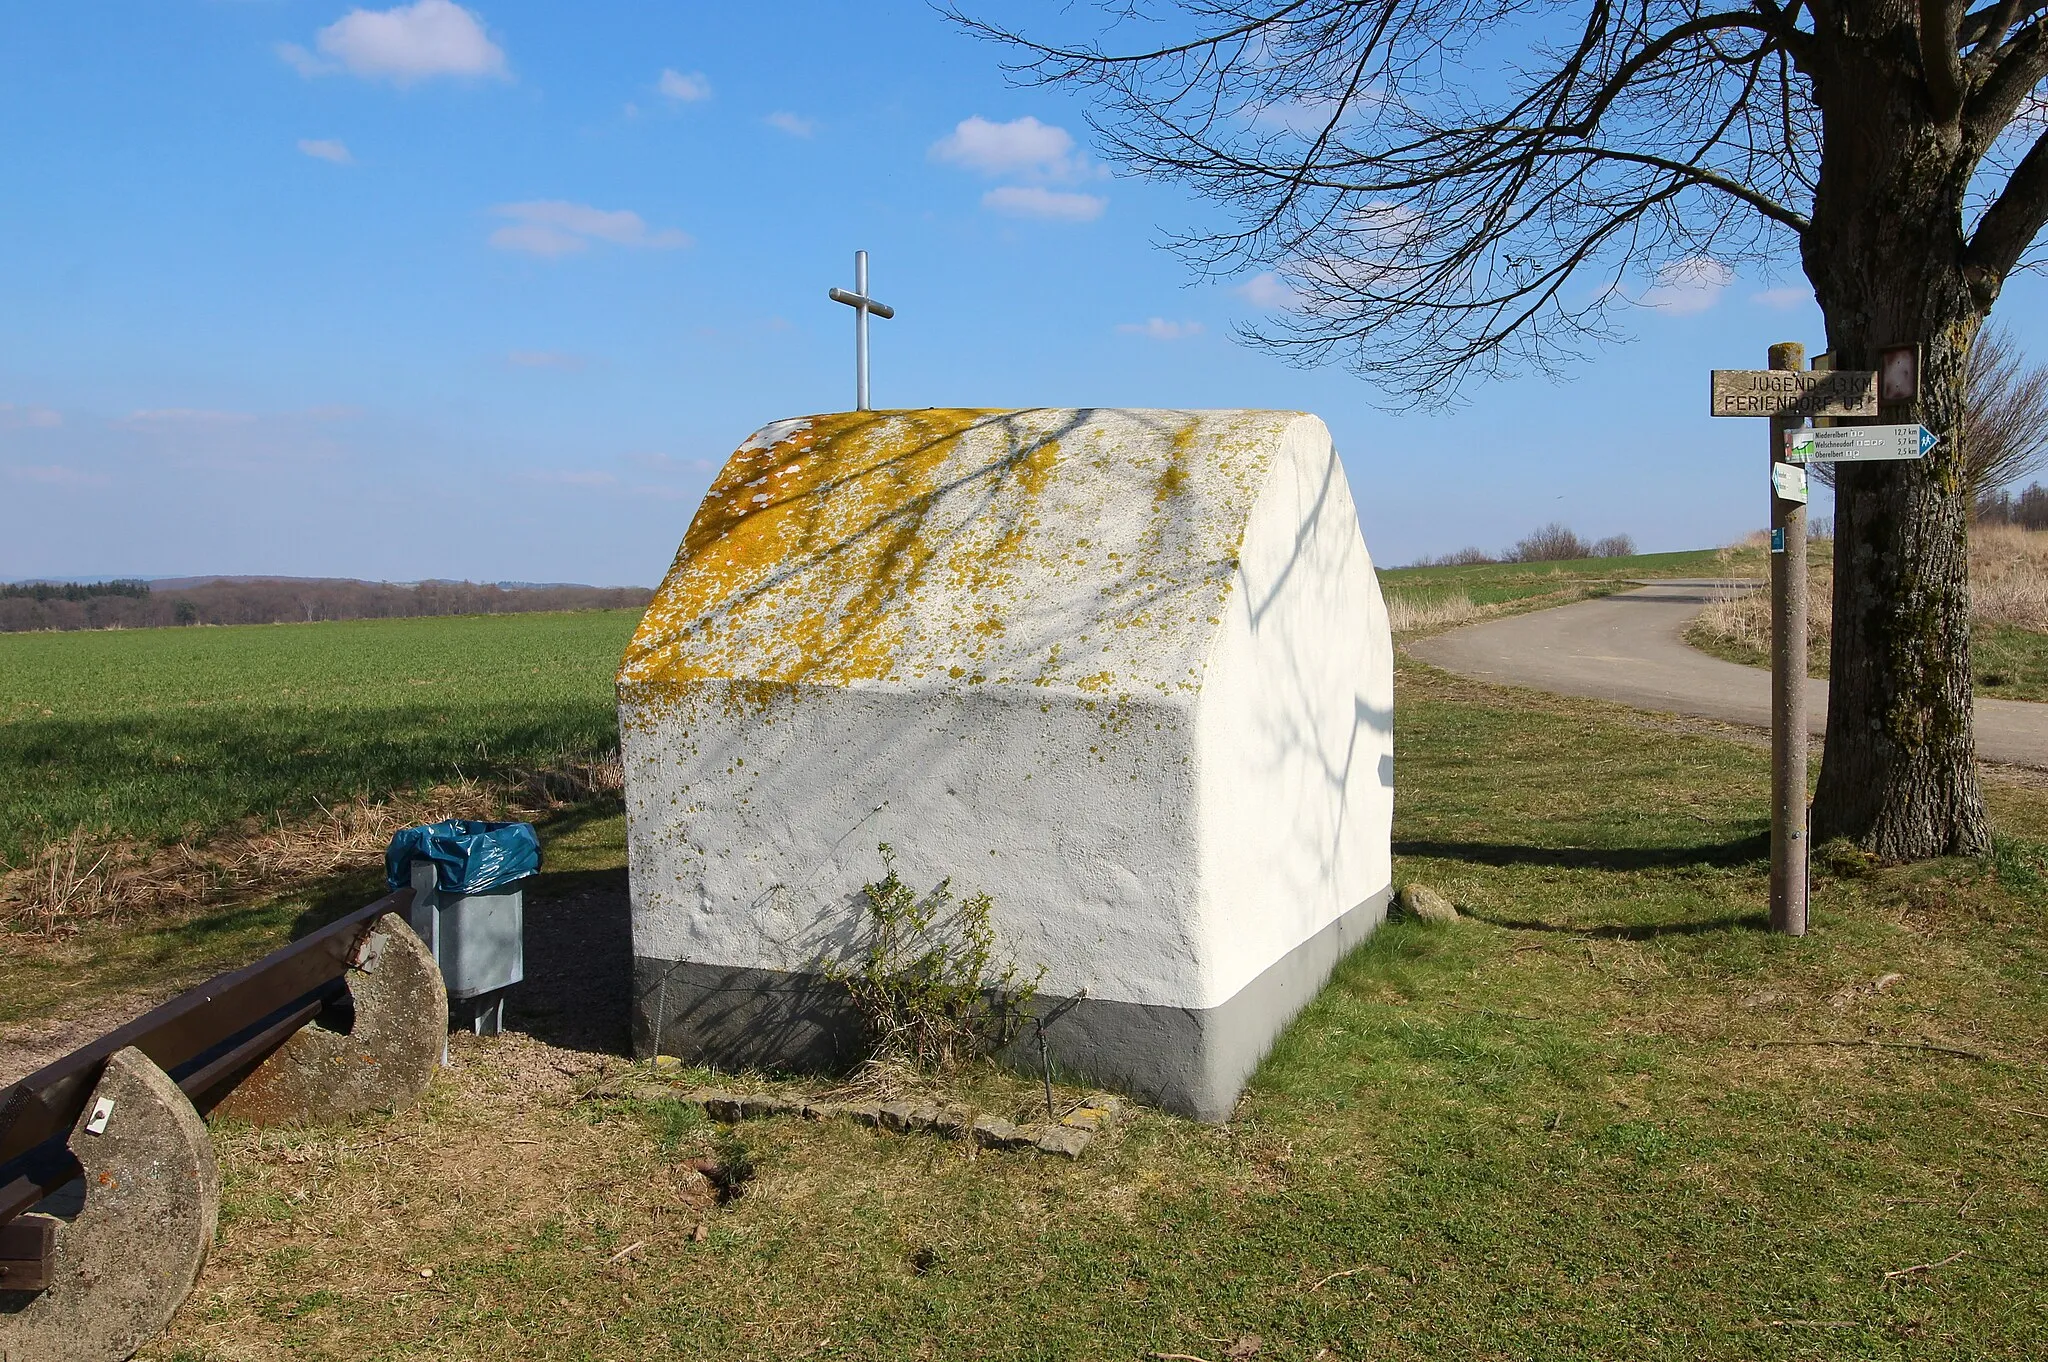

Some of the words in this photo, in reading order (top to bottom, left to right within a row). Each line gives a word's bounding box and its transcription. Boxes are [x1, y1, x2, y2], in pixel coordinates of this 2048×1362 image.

[1725, 396, 1832, 411] FERIENDORF
[1815, 431, 1848, 439] Niederelbert
[1815, 440, 1854, 448] Welschneudorf
